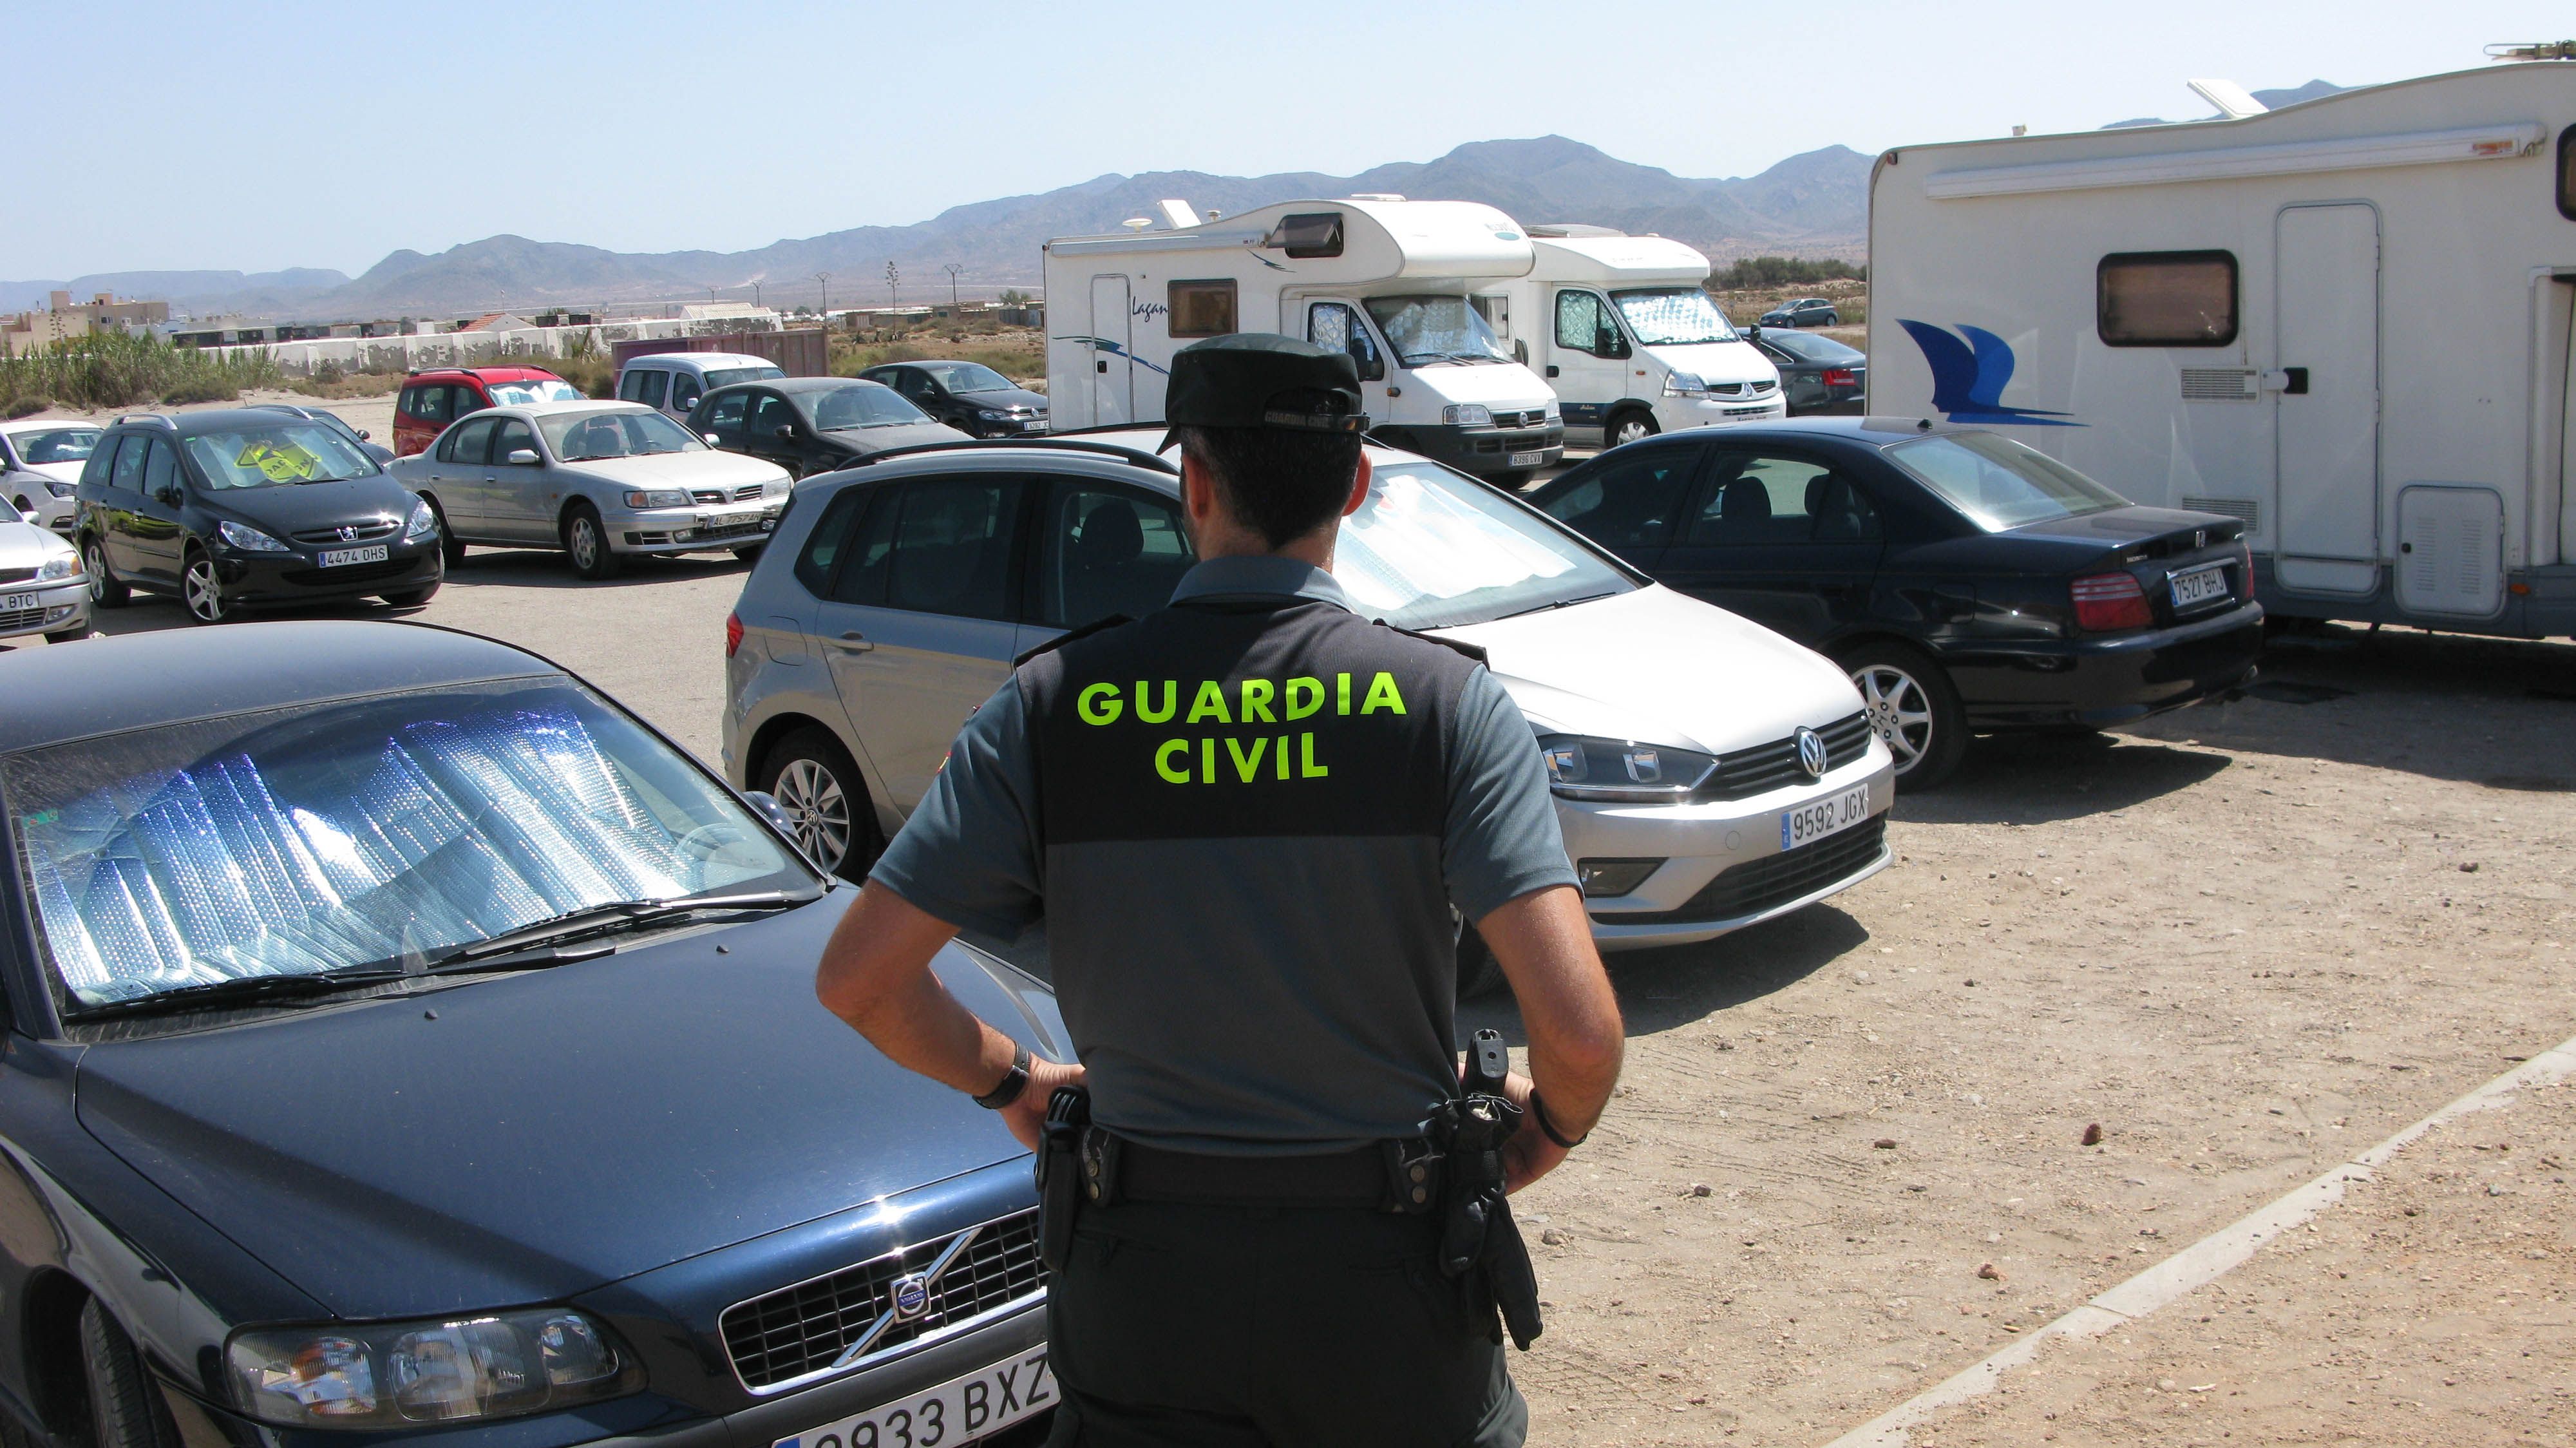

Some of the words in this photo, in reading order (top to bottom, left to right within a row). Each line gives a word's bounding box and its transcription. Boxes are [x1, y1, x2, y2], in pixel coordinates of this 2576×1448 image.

[1133, 296, 1168, 323] Lagan
[327, 551, 358, 564] 4474
[363, 548, 385, 561] DHS
[9, 594, 33, 609] BTC
[2175, 575, 2202, 602] 7527
[2204, 571, 2224, 594] BHJ
[1077, 672, 1407, 726] GUARDIA
[1155, 732, 1329, 784] CIVIL
[1794, 802, 1835, 840] 9592
[1840, 788, 1866, 824] JGX
[963, 1351, 1050, 1432] BXZ
